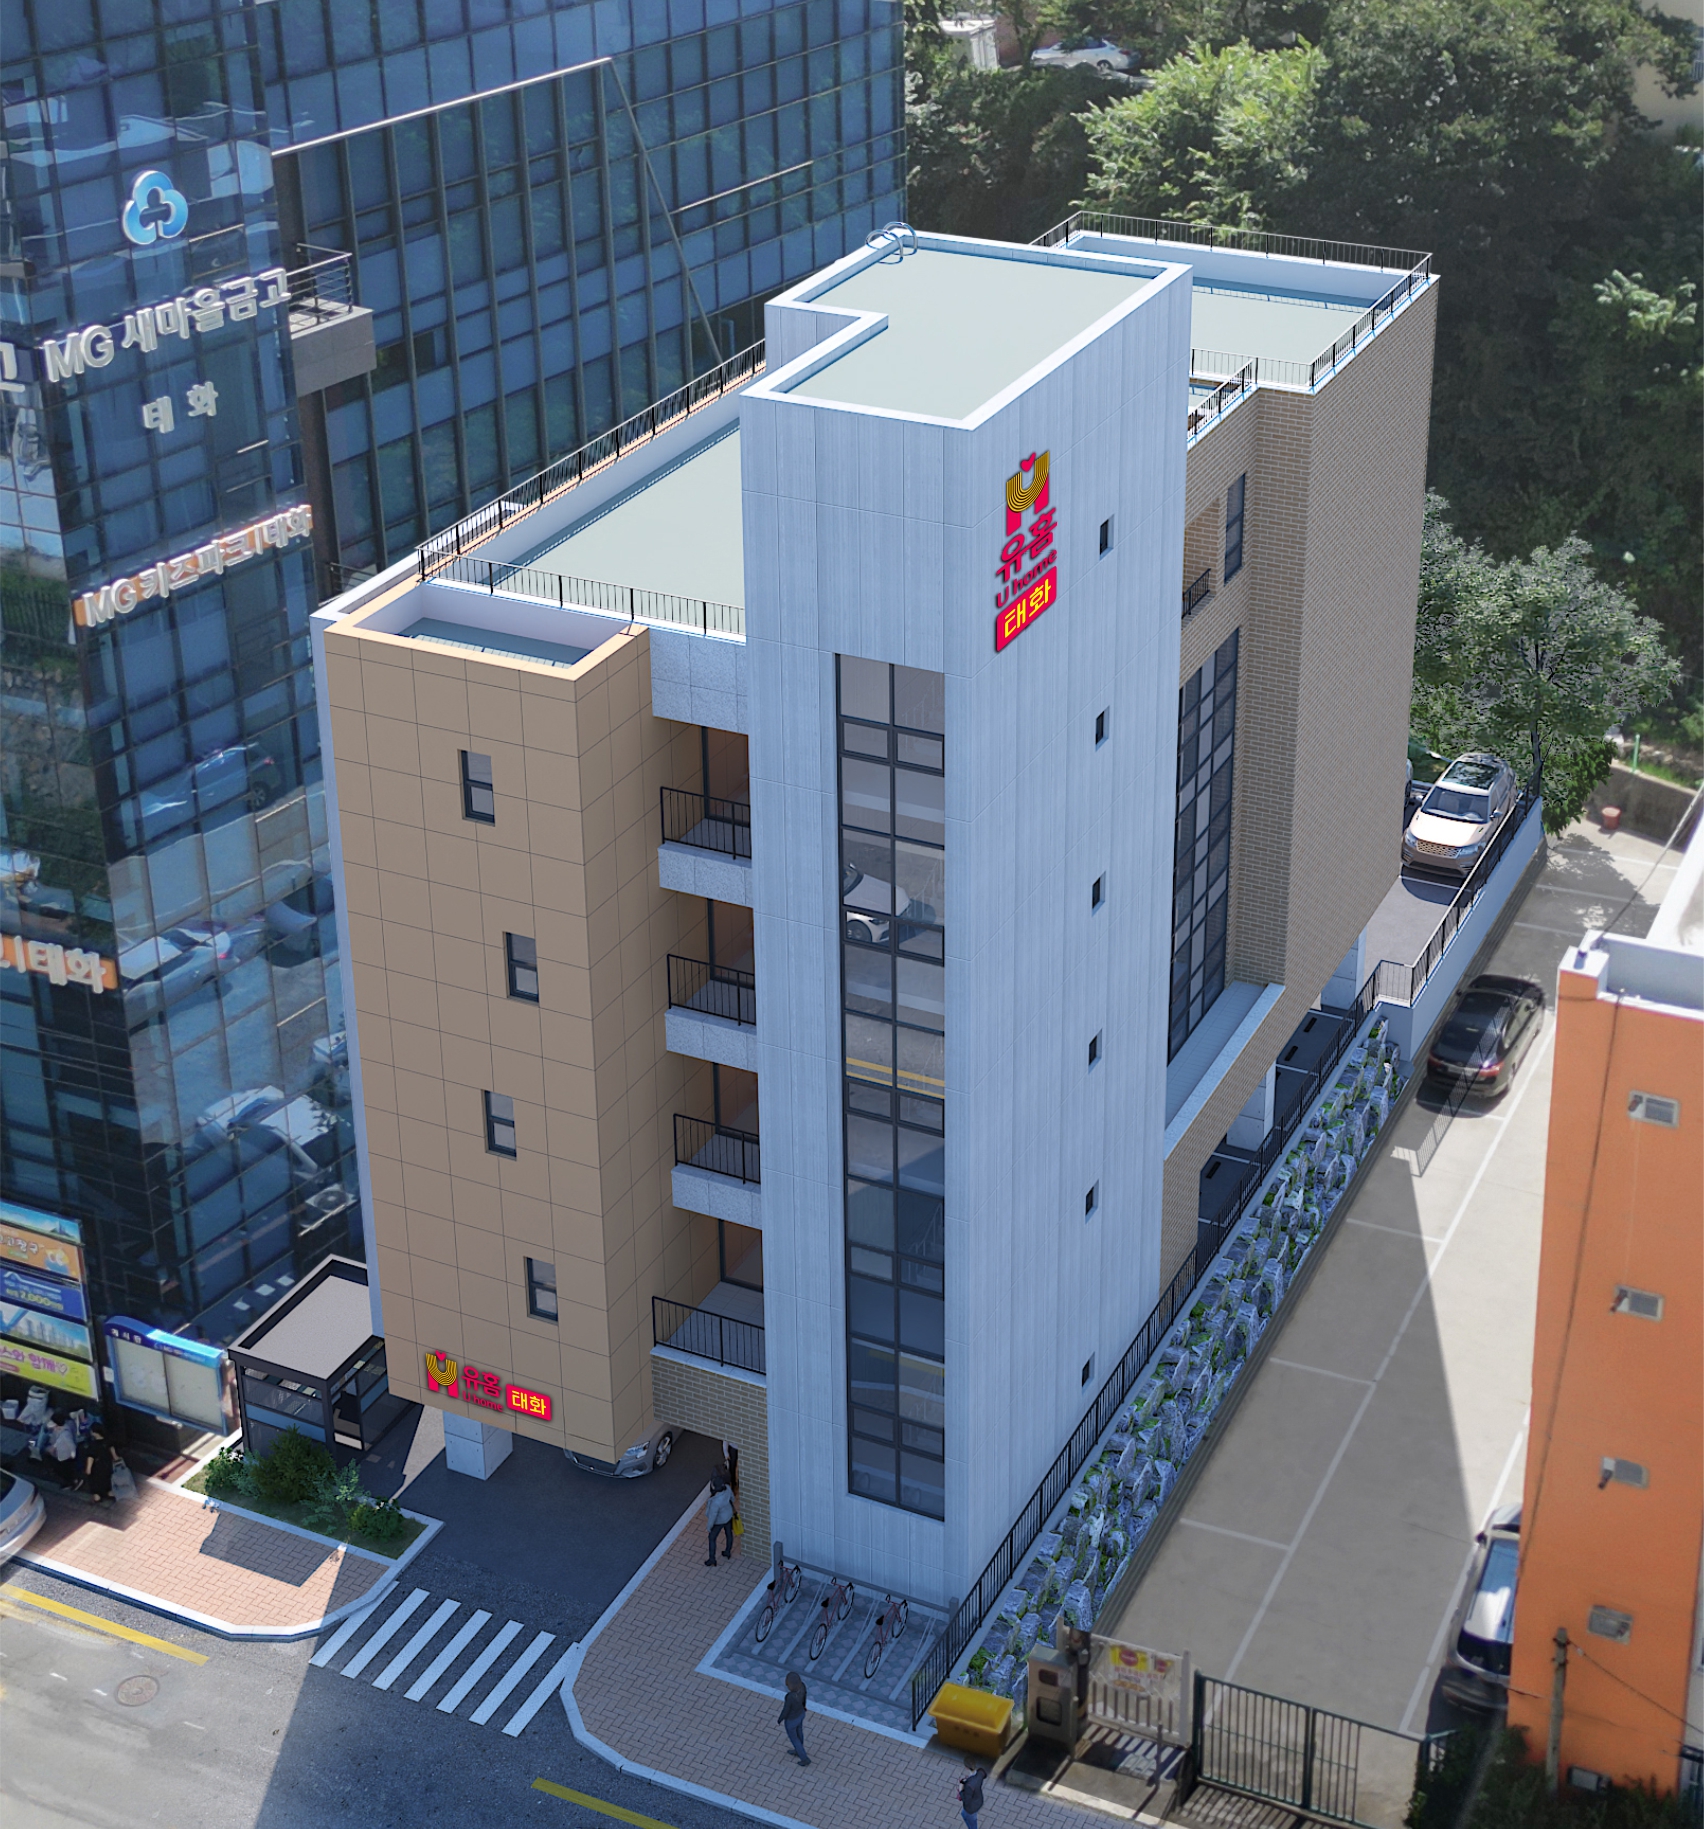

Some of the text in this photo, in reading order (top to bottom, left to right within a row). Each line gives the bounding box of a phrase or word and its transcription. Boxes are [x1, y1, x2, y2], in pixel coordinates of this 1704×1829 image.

[44, 324, 115, 383] MG
[121, 267, 291, 352] 새마을금고
[996, 507, 1058, 583] 유홈
[1012, 549, 1058, 597] home
[82, 577, 137, 627] MG
[1004, 578, 1052, 639] 태화
[461, 1365, 502, 1398] 유홈
[473, 1394, 504, 1413] home
[511, 1390, 547, 1416] 태화
